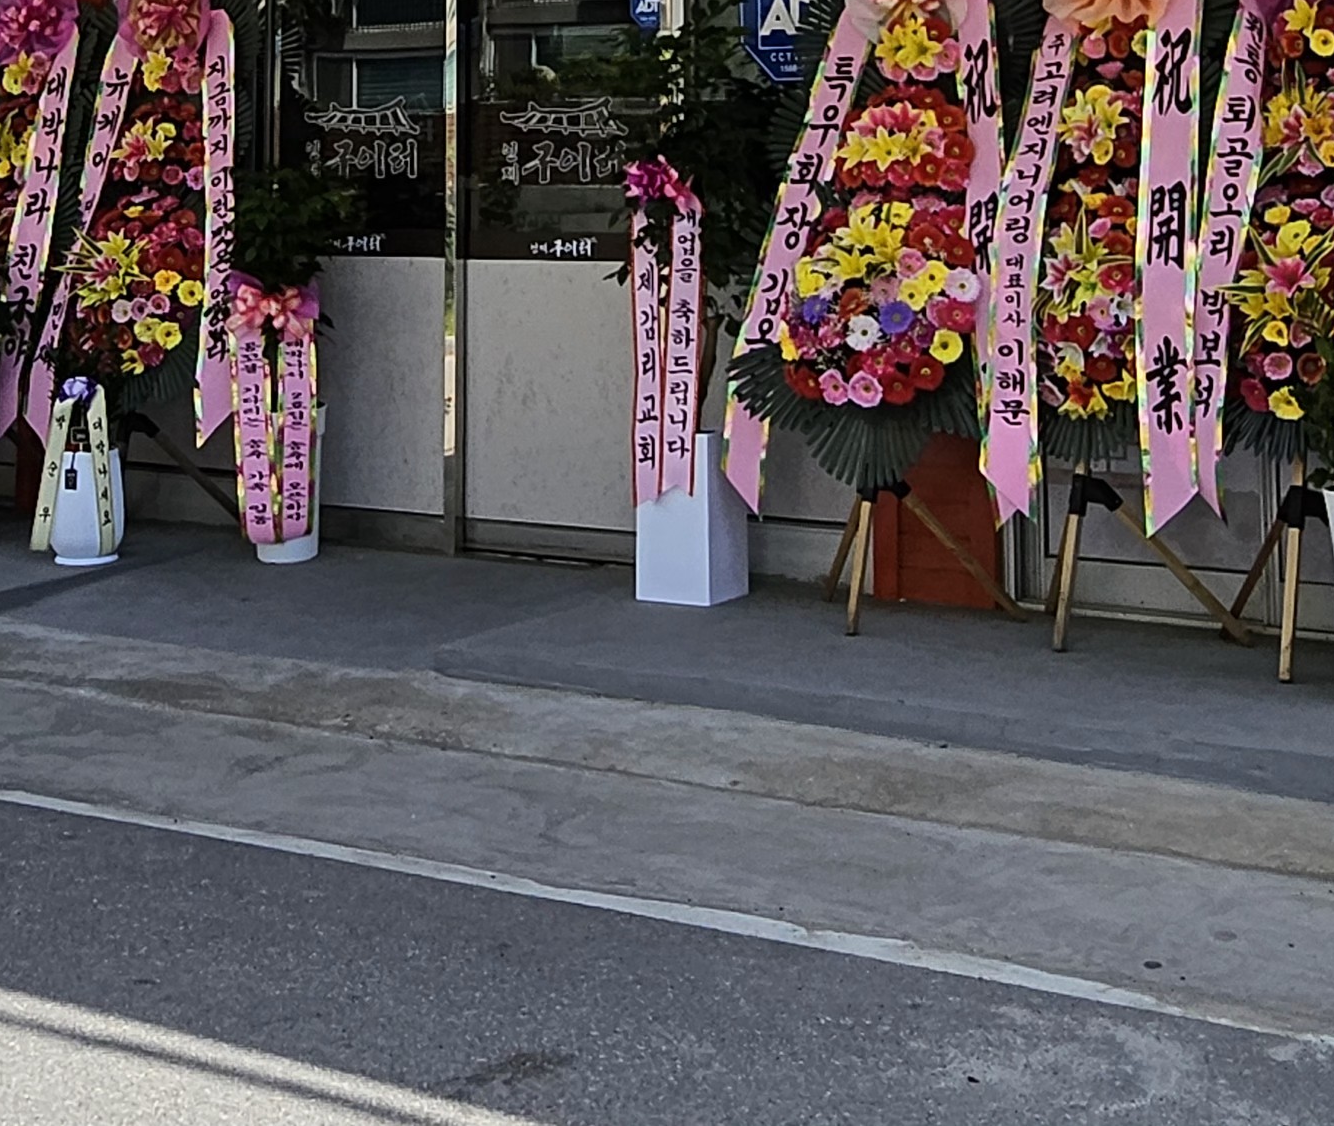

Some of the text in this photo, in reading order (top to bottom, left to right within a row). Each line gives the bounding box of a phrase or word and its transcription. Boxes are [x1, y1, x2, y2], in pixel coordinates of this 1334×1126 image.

[92, 69, 130, 170] 뉴케어
[207, 55, 230, 156] 지금까지
[777, 56, 855, 250] 특우회장
[324, 138, 418, 179] 구이터
[4, 66, 67, 358] 대박나라 친구야
[667, 209, 698, 460] 개업을 축하드립니다
[1001, 254, 1027, 329] 대표이사
[994, 338, 1031, 426] 이해문
